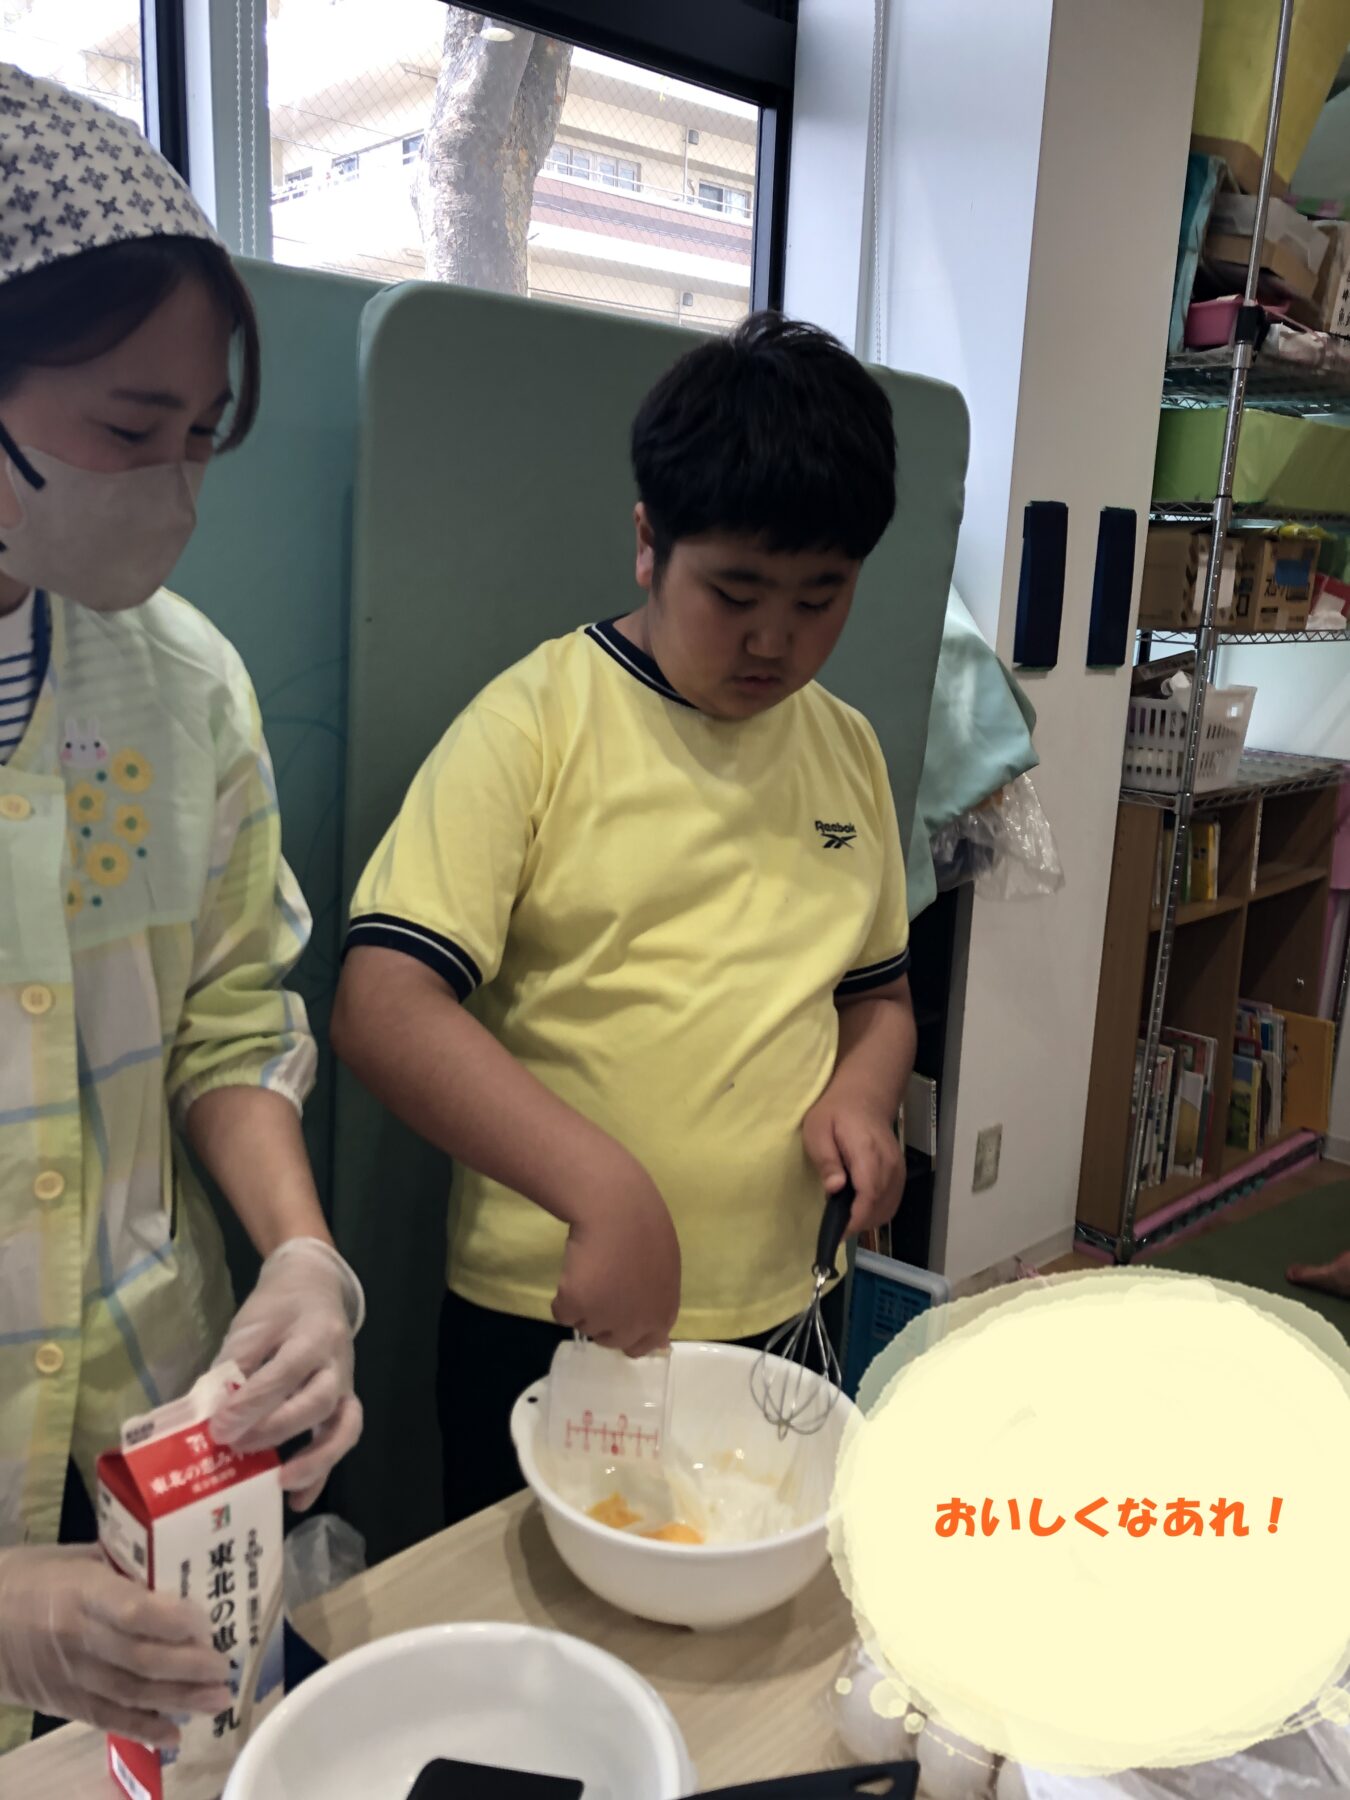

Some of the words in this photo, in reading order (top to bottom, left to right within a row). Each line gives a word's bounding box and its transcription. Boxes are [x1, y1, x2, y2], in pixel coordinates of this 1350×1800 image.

[815, 820, 857, 834] Reebok
[207, 1538, 241, 1738] 東北の恵乳
